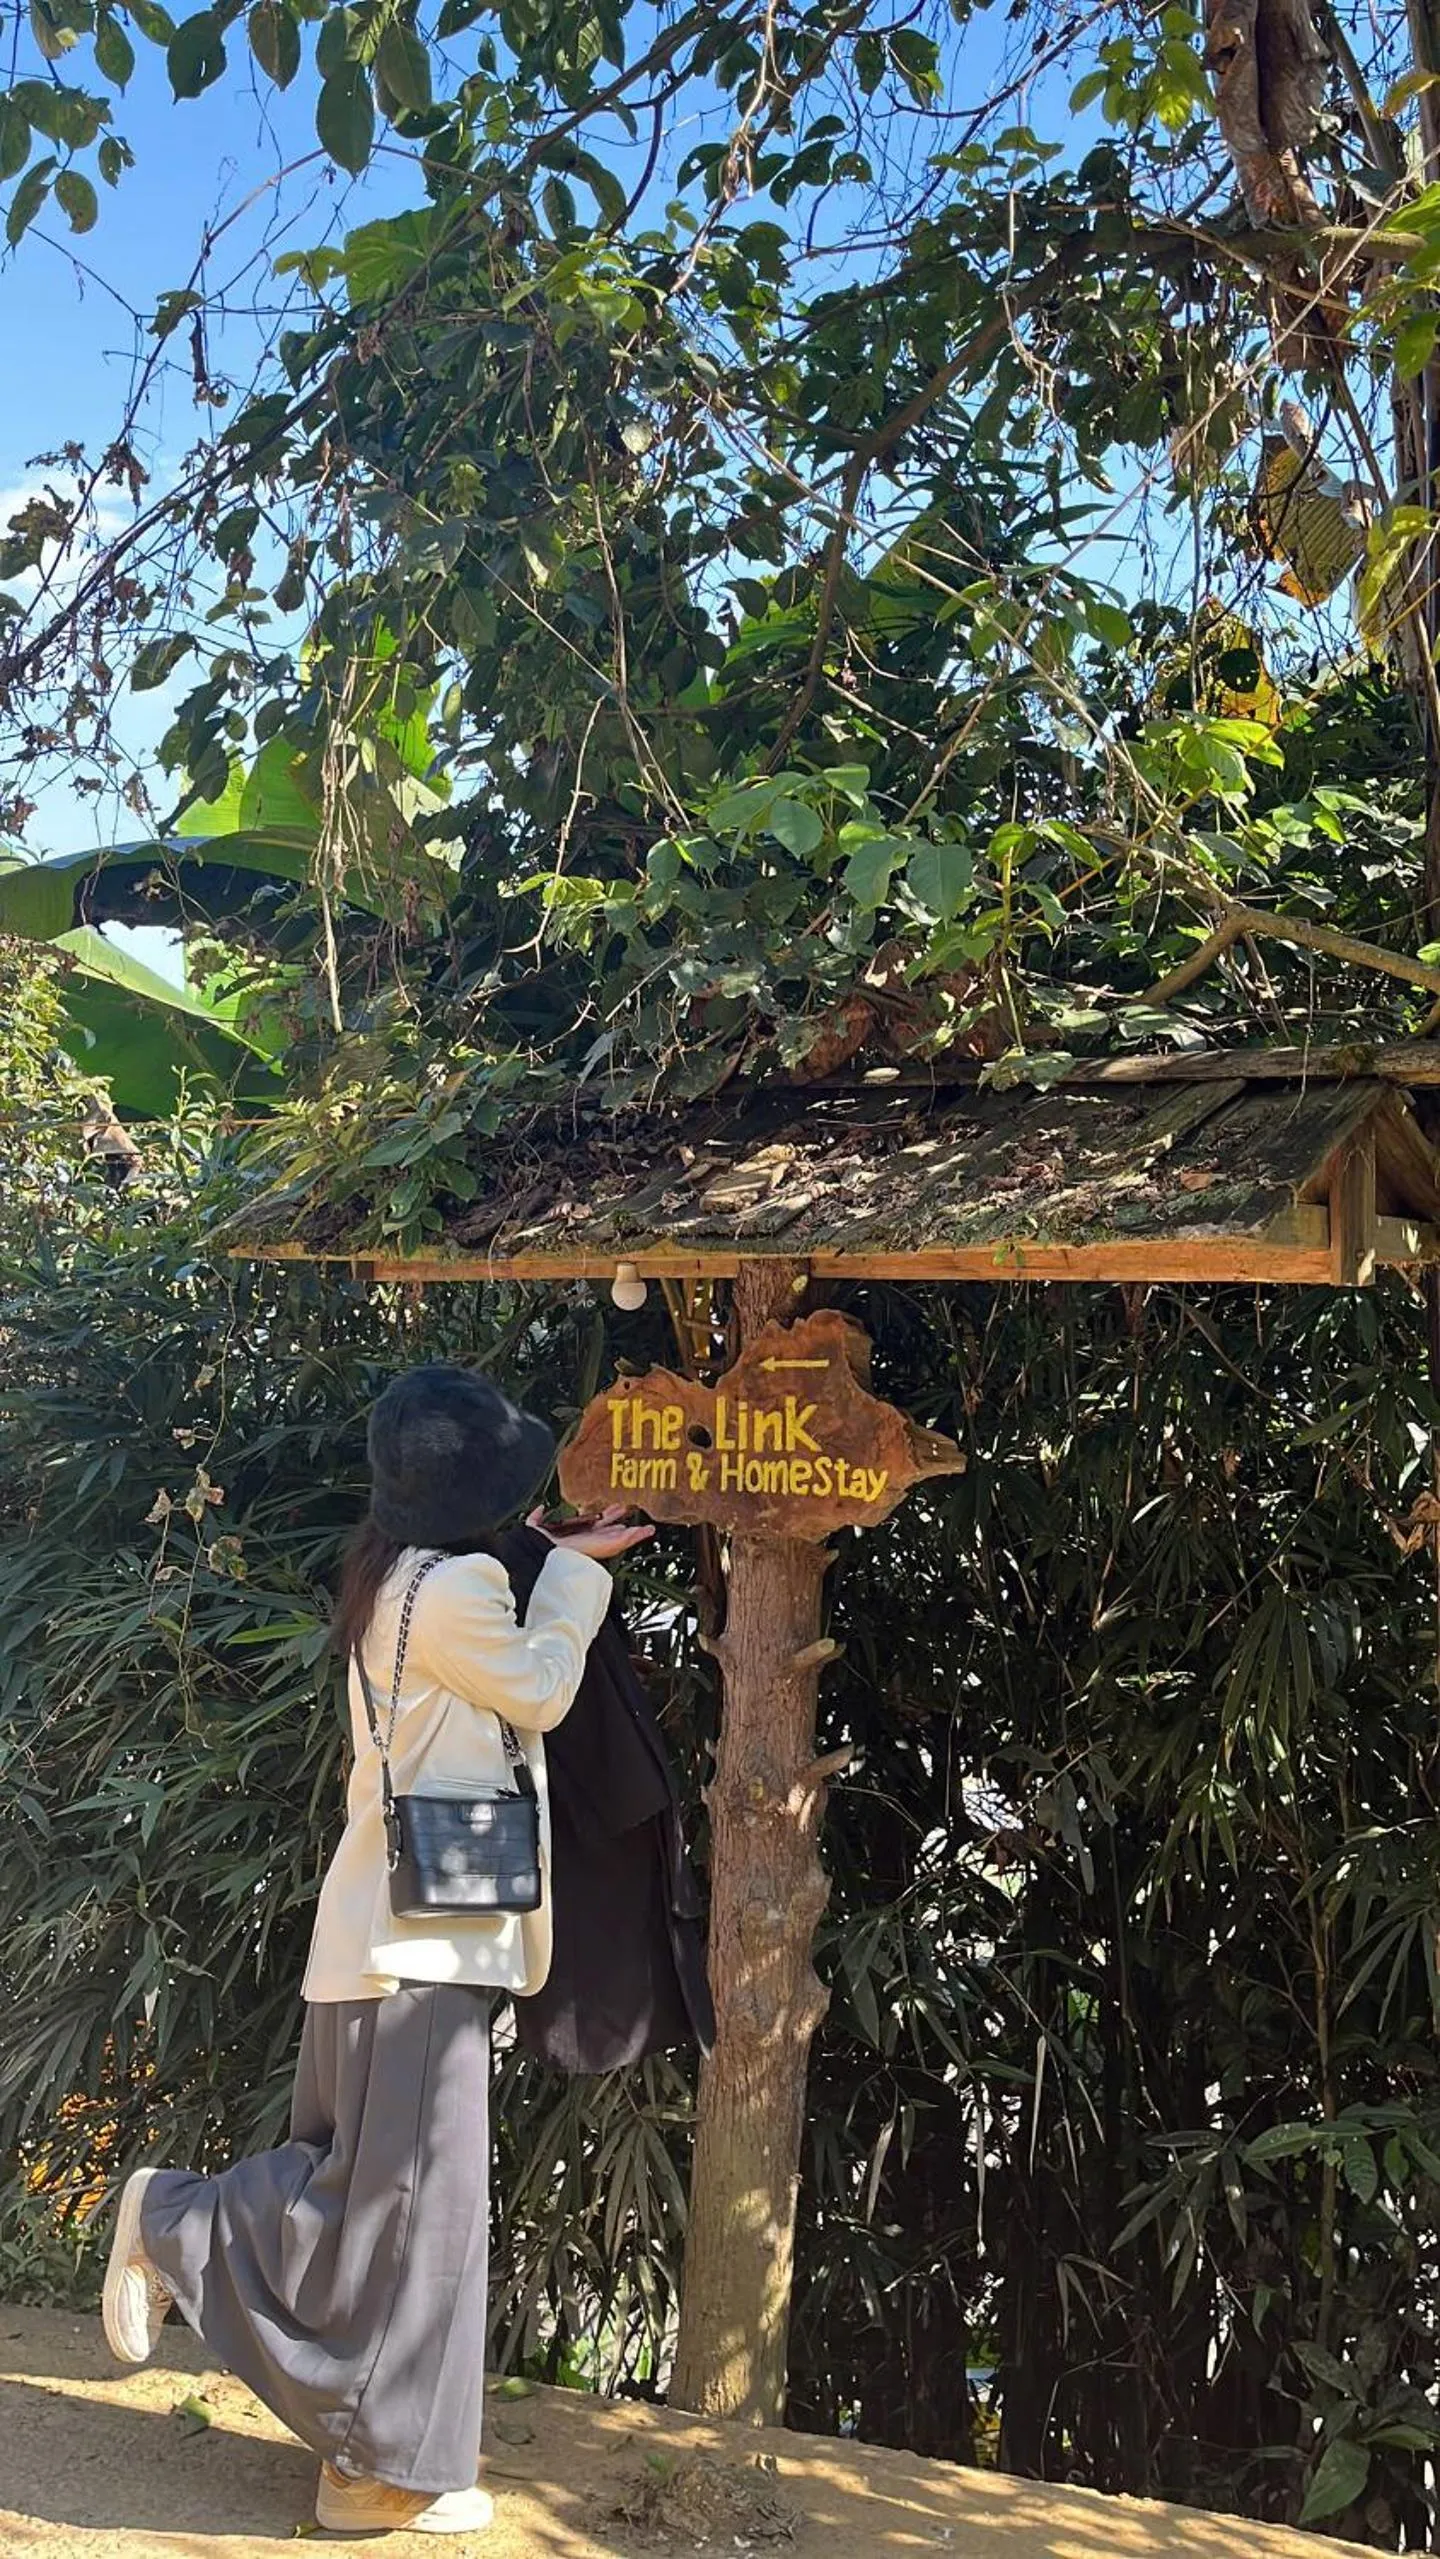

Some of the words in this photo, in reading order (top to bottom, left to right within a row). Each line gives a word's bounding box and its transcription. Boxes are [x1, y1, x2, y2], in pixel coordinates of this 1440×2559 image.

[607, 1398, 684, 1451] The
[610, 1453, 677, 1489] Farm
[686, 1452, 710, 1492] &
